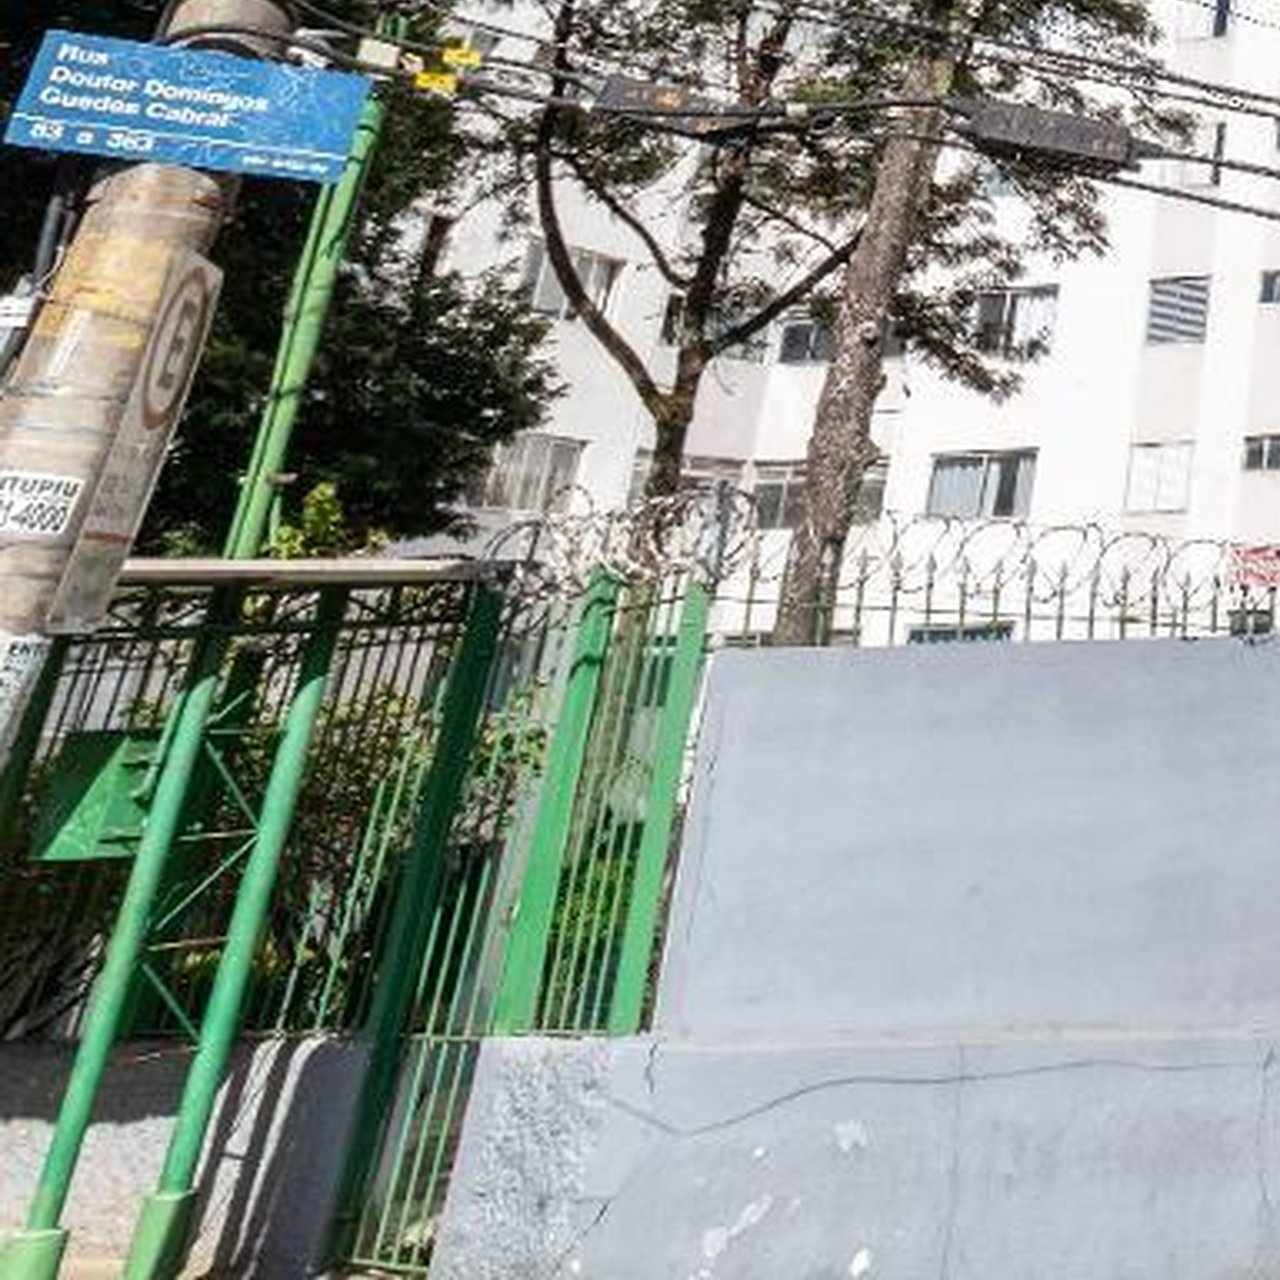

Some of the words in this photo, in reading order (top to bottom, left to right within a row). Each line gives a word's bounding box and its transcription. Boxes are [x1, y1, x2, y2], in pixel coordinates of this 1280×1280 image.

[57, 42, 109, 65] Rua
[40, 86, 140, 114] Guedes
[145, 102, 229, 127] Cabral
[49, 65, 140, 92] Doutor
[144, 79, 269, 112] Domingos
